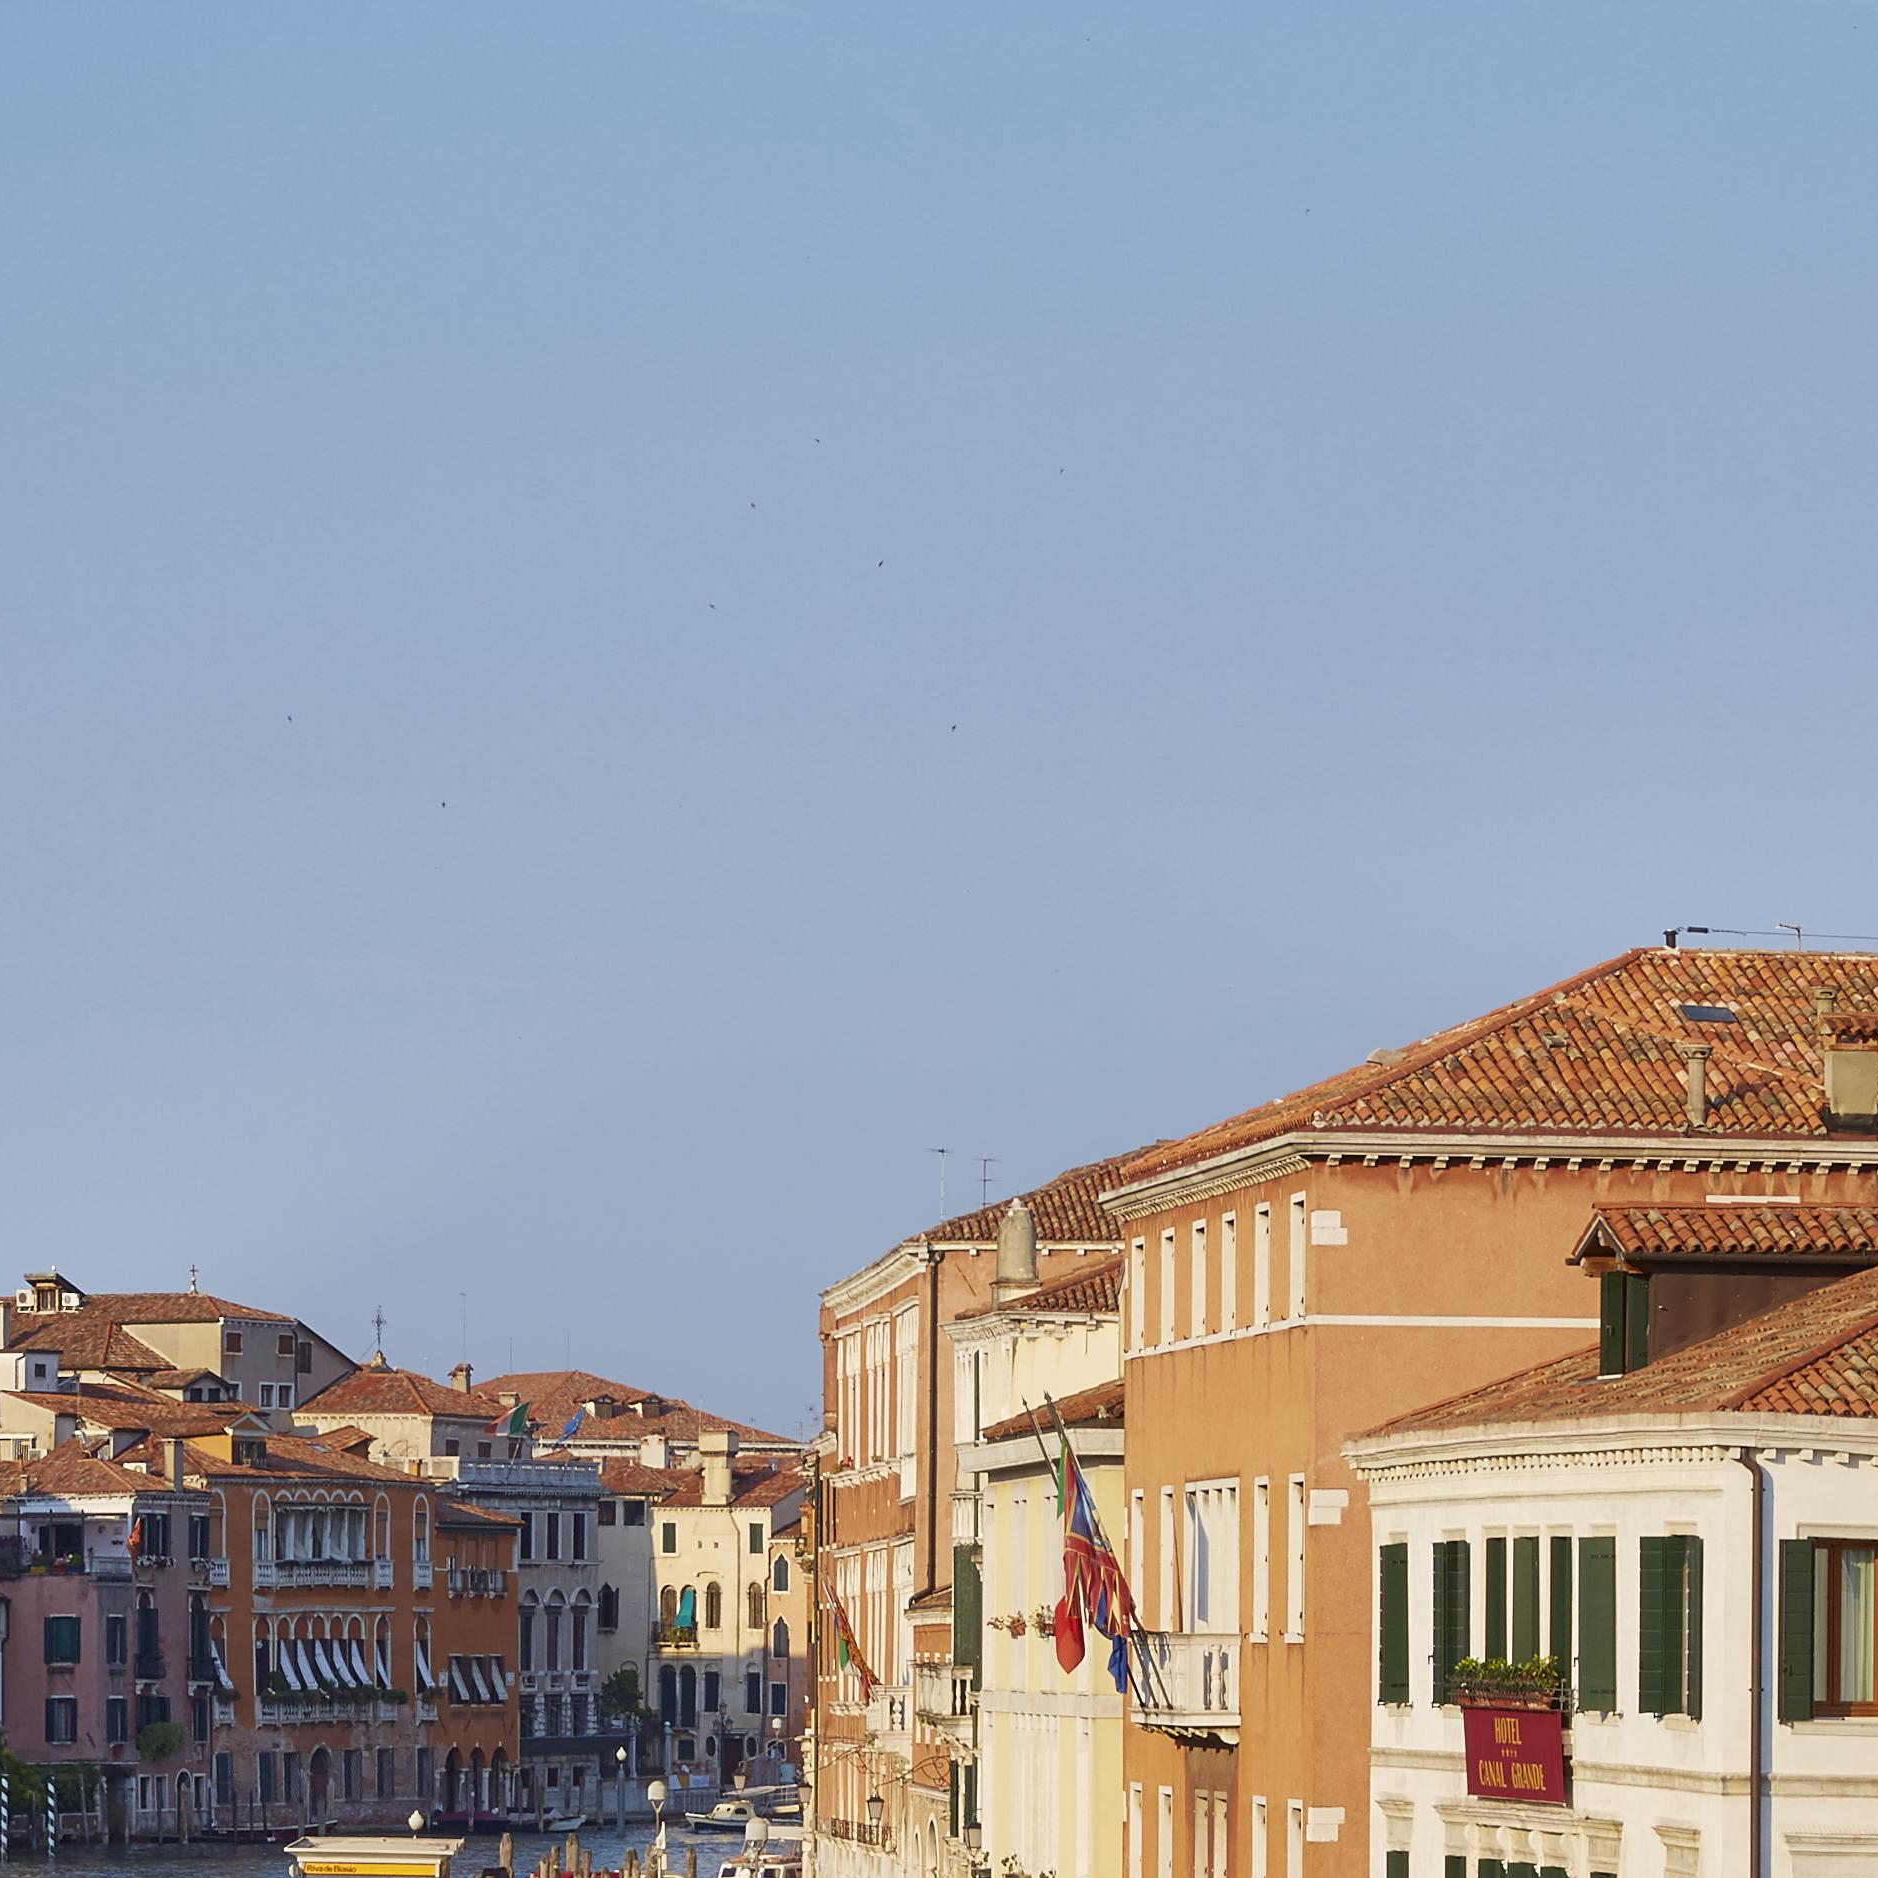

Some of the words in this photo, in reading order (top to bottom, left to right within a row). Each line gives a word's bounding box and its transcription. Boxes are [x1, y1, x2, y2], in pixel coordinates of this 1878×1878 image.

[1494, 1717, 1522, 1745] HOTEL
[1478, 1759, 1507, 1788] CANAL
[1511, 1762, 1547, 1791] GRANDE
[306, 1864, 323, 1872] Riva
[323, 1864, 333, 1873] de
[334, 1865, 356, 1873] Biasio
